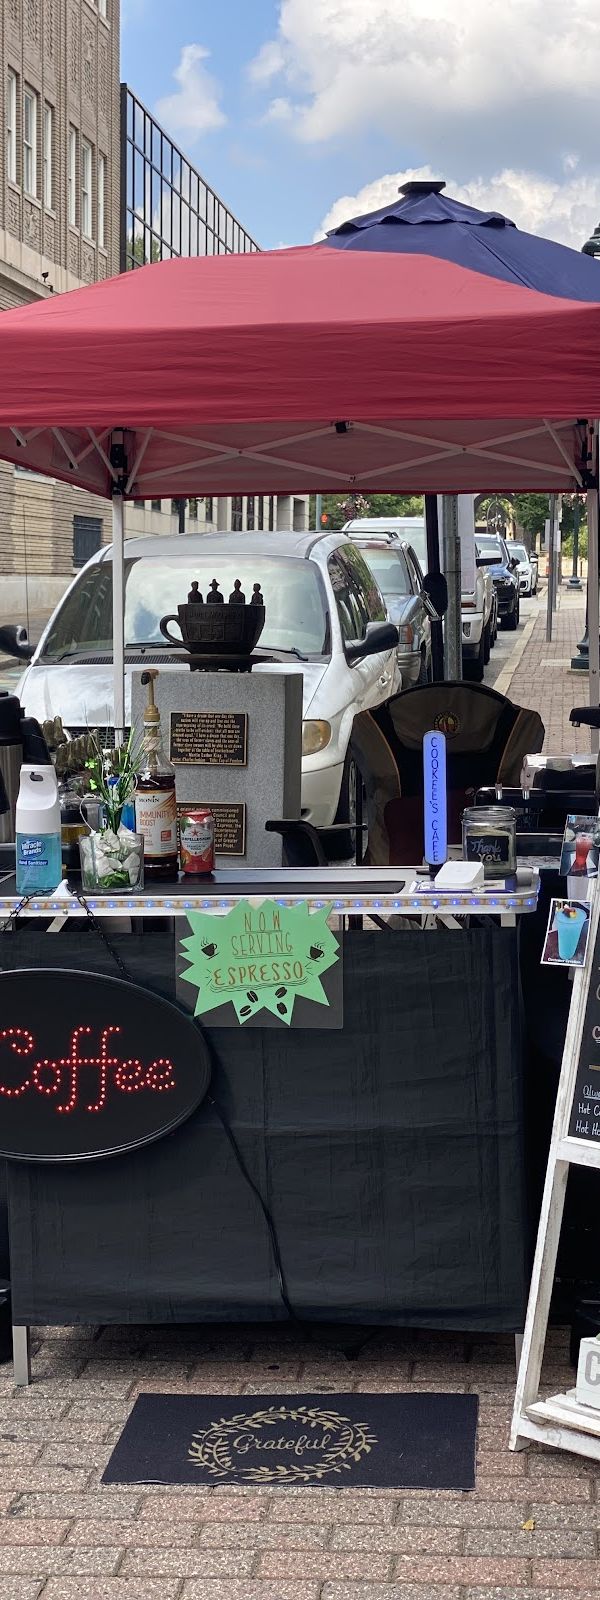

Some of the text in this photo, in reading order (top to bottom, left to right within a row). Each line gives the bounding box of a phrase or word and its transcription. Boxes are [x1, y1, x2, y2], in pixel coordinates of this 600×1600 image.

[431, 820, 439, 862] CAFE
[471, 839, 502, 853] Thank
[244, 910, 282, 931] NOW
[231, 933, 293, 956] SERVING
[213, 961, 304, 986] ESPRESSO
[0, 1025, 176, 1113] Coffee
[579, 1103, 591, 1115] Hot
[576, 1120, 589, 1134] Hot
[232, 1434, 331, 1456] Grateful
